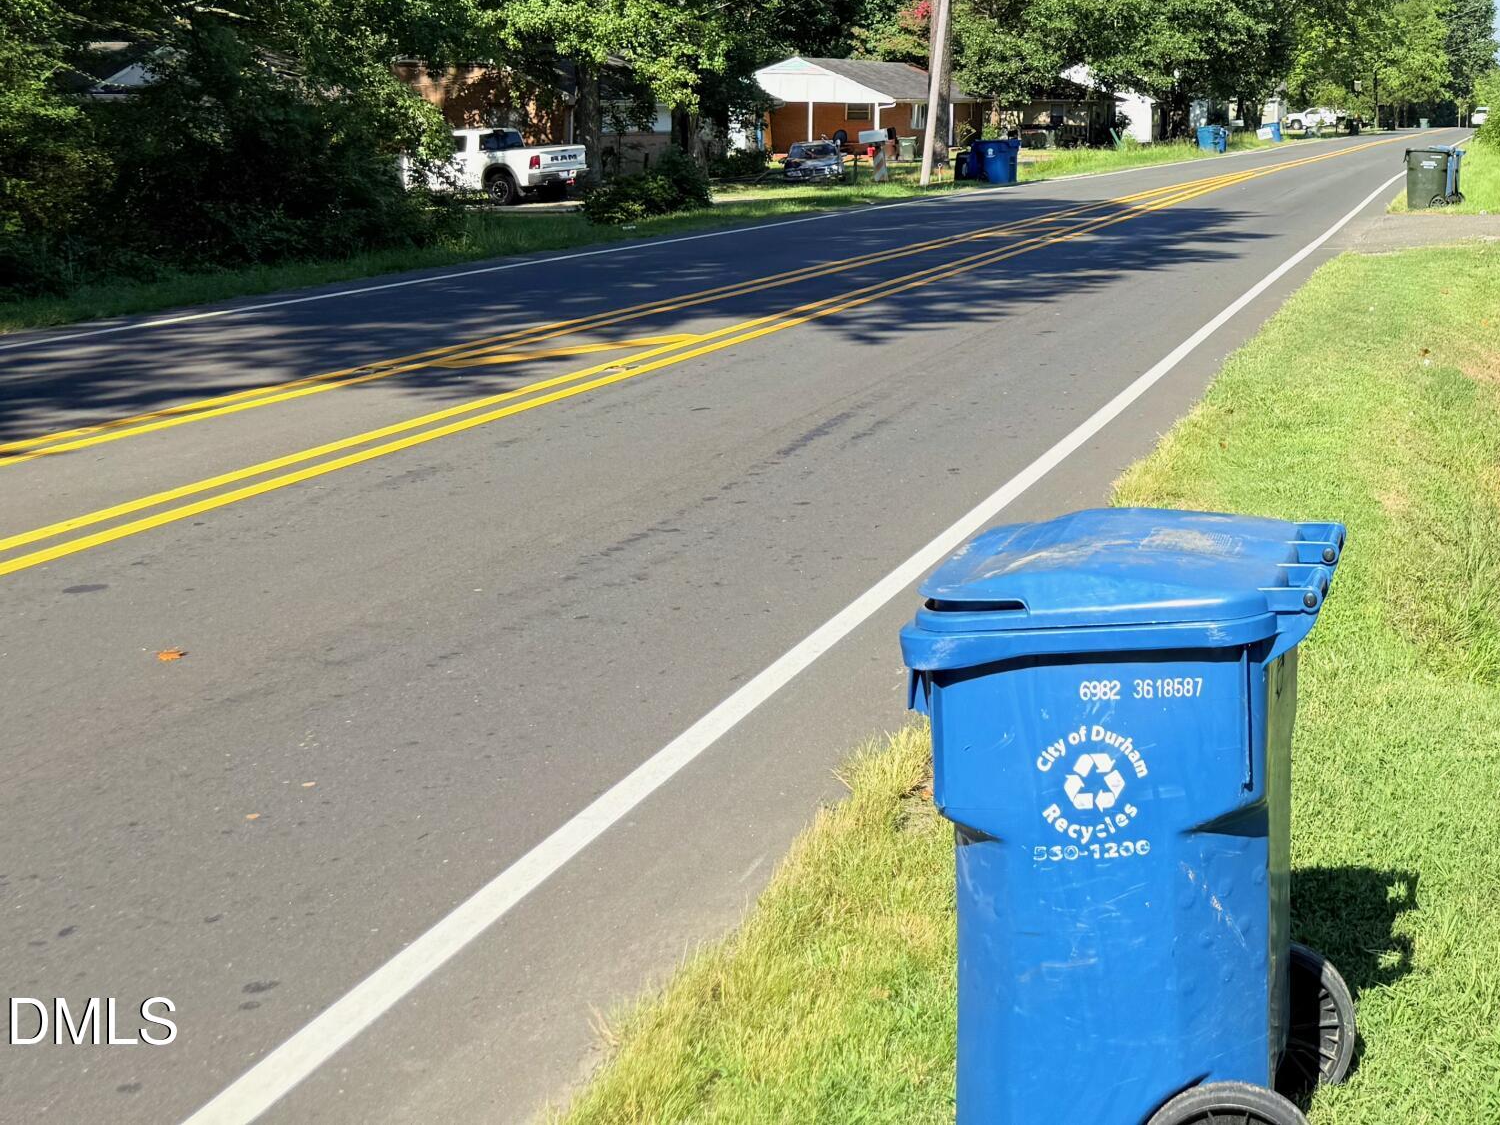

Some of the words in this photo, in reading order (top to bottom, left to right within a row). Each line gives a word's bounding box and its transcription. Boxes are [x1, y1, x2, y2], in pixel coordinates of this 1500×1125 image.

[550, 154, 577, 162] RAM
[1079, 680, 1121, 700] 6982
[1133, 678, 1203, 698] 3618587
[1036, 738, 1067, 772] City
[1068, 725, 1087, 745] of
[1091, 725, 1148, 779] Durham
[1042, 803, 1138, 844] Recycles
